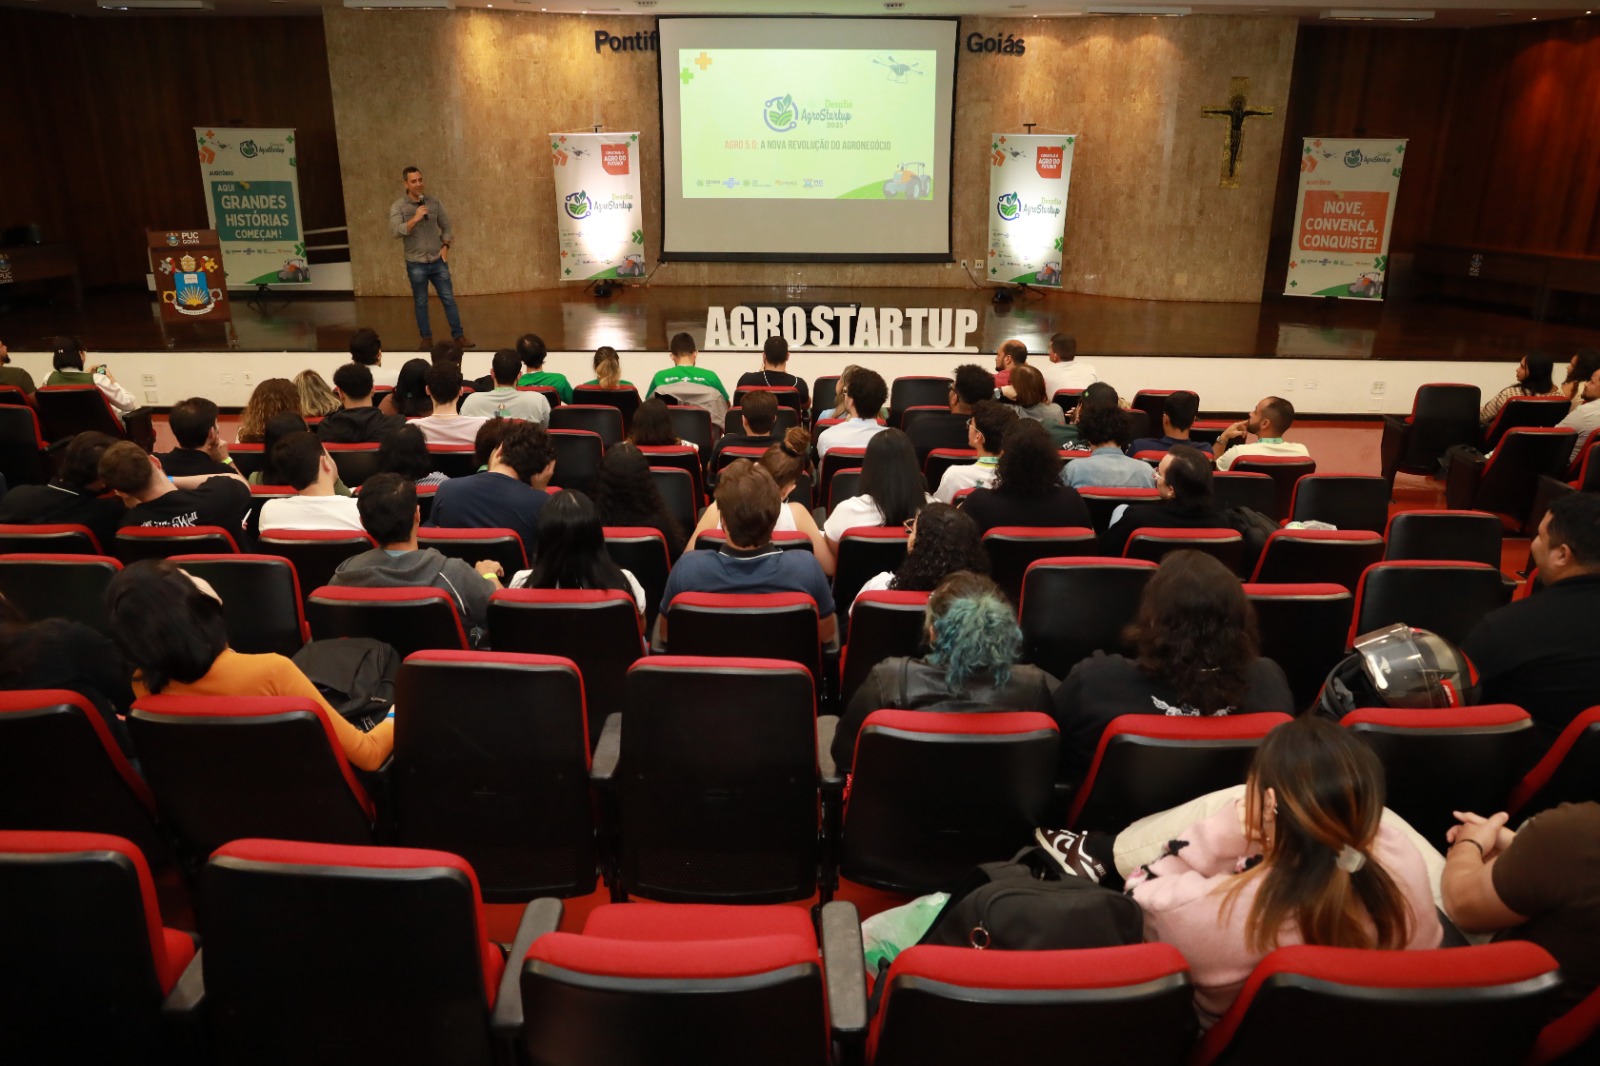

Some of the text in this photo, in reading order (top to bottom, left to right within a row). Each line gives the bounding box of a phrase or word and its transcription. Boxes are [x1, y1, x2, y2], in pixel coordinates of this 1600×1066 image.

[967, 32, 1026, 57] Goiás
[801, 108, 852, 125] AgroStartup
[724, 140, 744, 150] AGRO
[760, 140, 766, 150] A
[767, 140, 787, 150] NOVA
[788, 138, 830, 152] REVOLUÇÃO
[831, 140, 840, 150] DO
[842, 138, 892, 151] AGRONEGÓCIO
[217, 184, 235, 192] AQUI
[221, 194, 287, 209] GRANDES
[1323, 201, 1366, 216] INOVE,
[225, 210, 290, 227] HISTÓRIAS
[1305, 217, 1378, 236] CONVENÇA,
[181, 231, 199, 239] PUC
[235, 229, 283, 241] COMEÇAM!
[1303, 234, 1378, 250] CONQUISTE!
[705, 305, 978, 349] AGROSTARTUP
